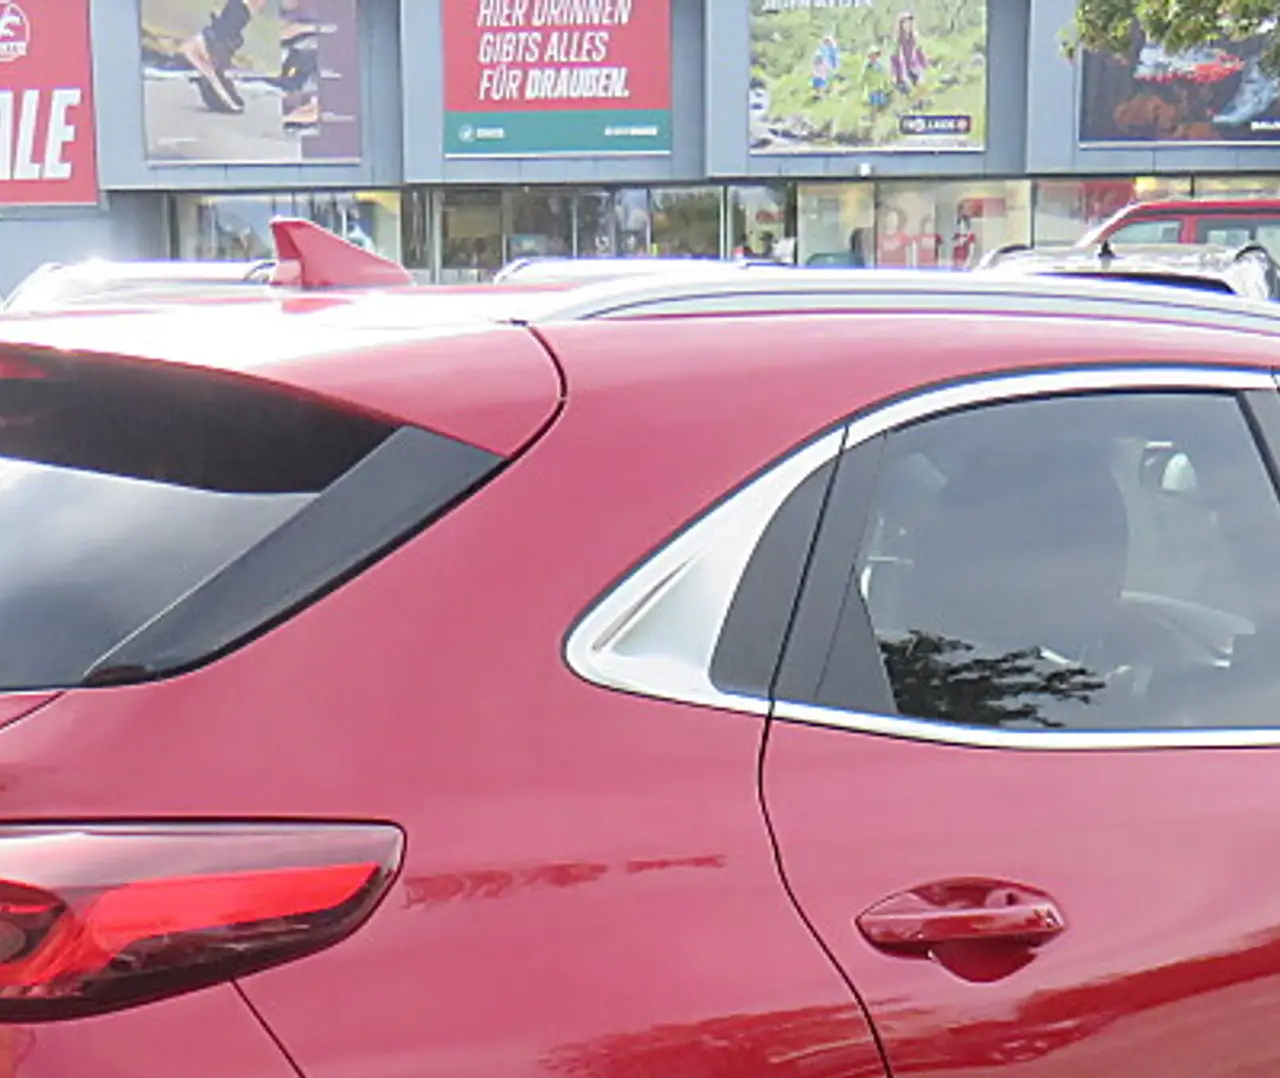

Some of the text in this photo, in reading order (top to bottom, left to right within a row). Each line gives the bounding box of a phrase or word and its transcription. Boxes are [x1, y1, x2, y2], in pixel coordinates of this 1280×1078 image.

[476, 0, 632, 27] HIER DRINNEN
[478, 30, 610, 64] GIBTS ALLES
[479, 64, 524, 101] FÜR
